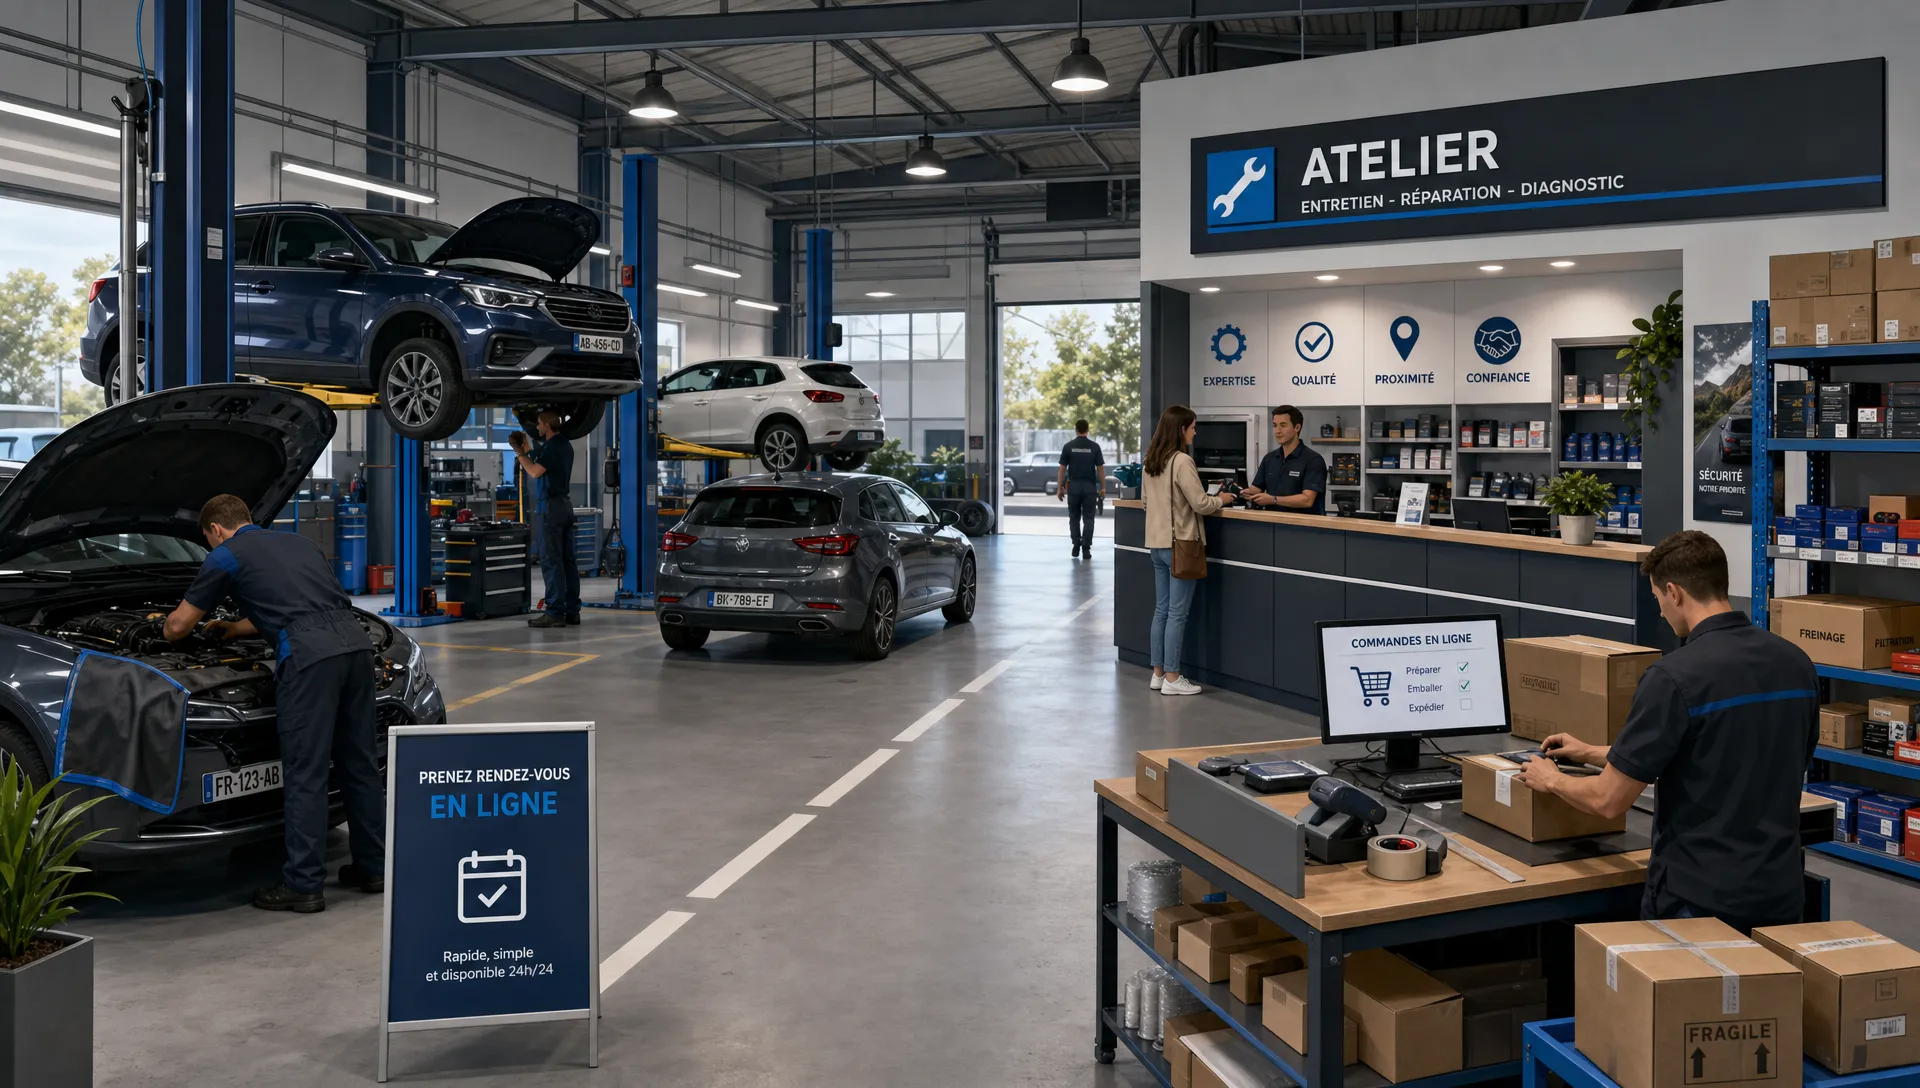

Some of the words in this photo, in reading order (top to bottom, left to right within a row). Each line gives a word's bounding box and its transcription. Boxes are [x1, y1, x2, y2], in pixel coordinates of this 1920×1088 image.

[1301, 129, 1499, 186] ATELIER
[1301, 195, 1384, 213] ENTRETIEN
[1400, 184, 1502, 207] RÉPARATION
[1521, 174, 1624, 197] DIAGNOSTIC
[580, 337, 621, 351] AB-456-CD
[1203, 375, 1256, 387] EXPERTISE
[1291, 373, 1337, 387] QUALITÉ
[1375, 371, 1435, 384] PROXIMITÉ
[1466, 372, 1530, 384] CONFIANCE
[1699, 467, 1743, 482] SÉCURITÉ
[716, 594, 770, 607] BK-789-EF
[1351, 635, 1422, 649] COMMANDES
[1425, 635, 1439, 645] EN
[1442, 633, 1472, 644] LIGNE
[1799, 628, 1845, 643] FREINAGE
[1406, 665, 1441, 676] Préparer
[1407, 683, 1443, 693] Emballer
[1409, 702, 1445, 714] Expédier
[215, 765, 280, 797] FR-123-AB
[419, 770, 472, 784] PRENEZ
[476, 767, 571, 783] RENDEZ-VOUS
[430, 794, 467, 819] EN
[477, 791, 558, 817] LIGNE
[443, 949, 490, 965] Rapide,
[493, 947, 534, 963] simple
[426, 970, 438, 982] et
[441, 966, 505, 983] disponible
[509, 963, 554, 978] 24h/24
[1689, 1023, 1772, 1043] FRAGILE
